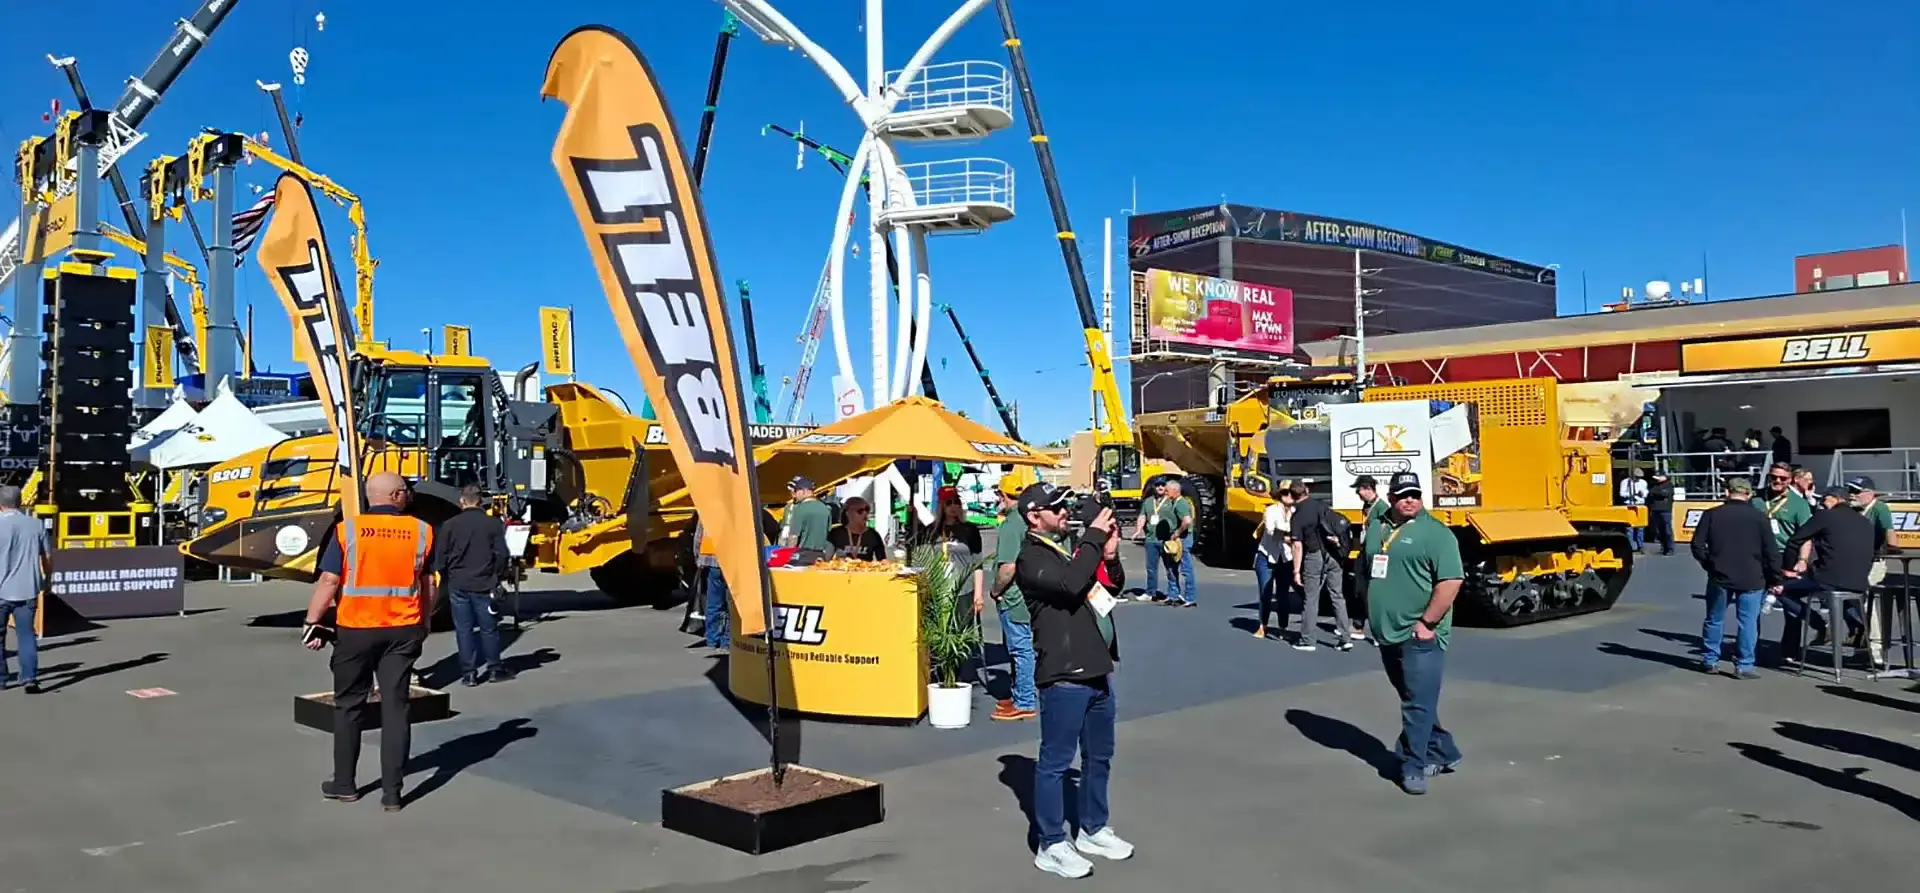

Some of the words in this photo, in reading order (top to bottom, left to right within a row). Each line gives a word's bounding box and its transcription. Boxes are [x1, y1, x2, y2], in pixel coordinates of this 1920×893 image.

[1304, 220, 1375, 248] AFTER-SHOW
[1376, 229, 1419, 256] RECEPTION
[575, 126, 737, 466] BELL
[1168, 275, 1191, 293] WE
[1195, 280, 1239, 299] KNOW
[1243, 286, 1276, 306] REAL
[1252, 310, 1273, 321] MAX
[1781, 335, 1870, 362] BELL
[748, 426, 784, 439] ADED
[212, 467, 252, 483] B20E
[65, 570, 118, 582] RELIABLE
[119, 567, 178, 580] MACHINES
[68, 581, 121, 594] RELIABLE
[122, 579, 175, 591] SUPPORT
[771, 604, 828, 645] ELL
[810, 651, 843, 664] Reliable
[844, 654, 880, 665] Support
